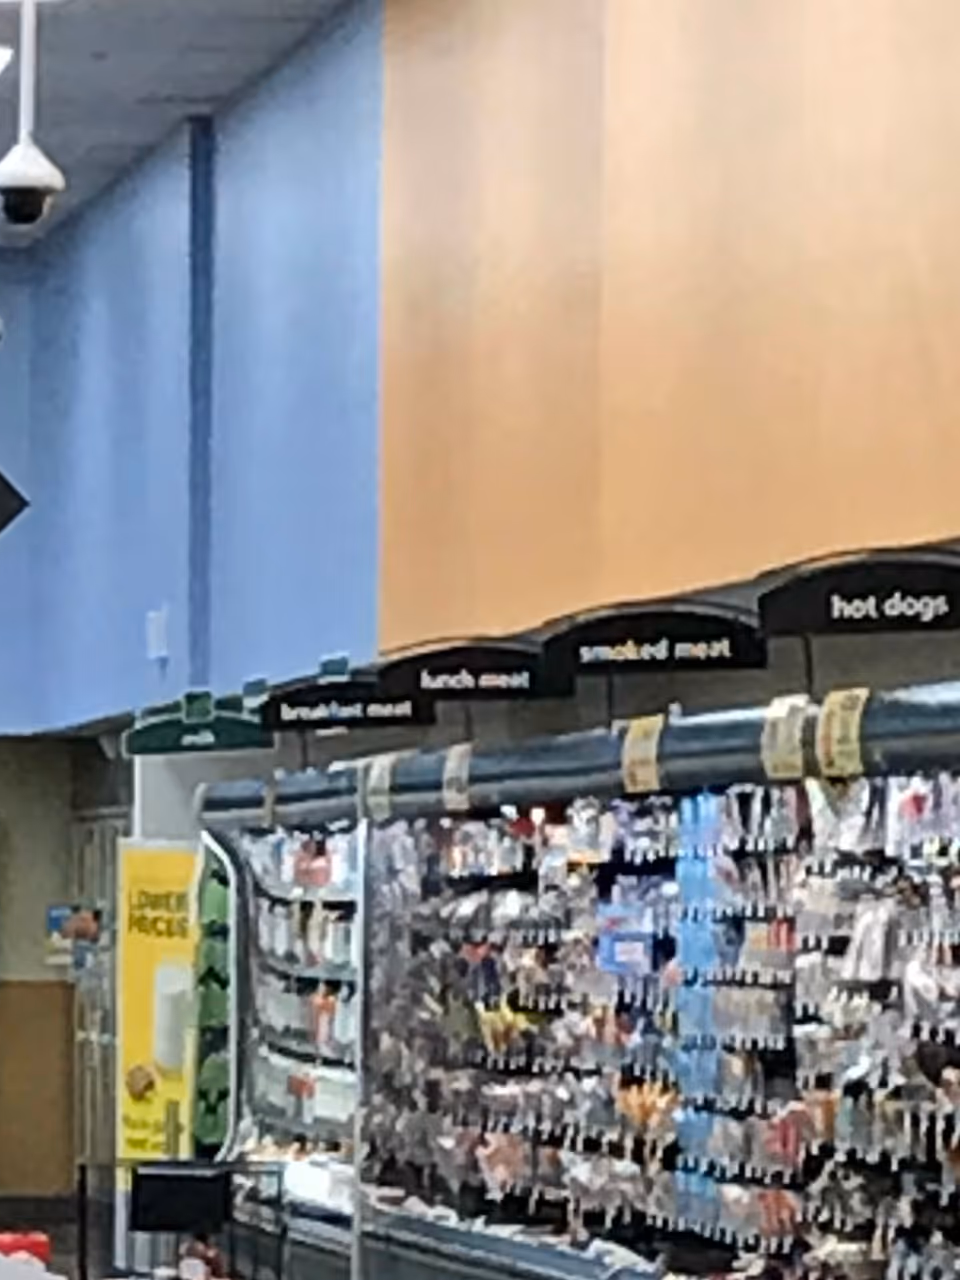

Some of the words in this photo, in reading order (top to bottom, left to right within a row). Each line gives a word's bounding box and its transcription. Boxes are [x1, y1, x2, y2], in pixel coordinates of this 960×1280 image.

[831, 594, 878, 620] hot
[883, 591, 949, 622] dogs
[579, 638, 669, 662] smoked
[674, 638, 732, 659] meat
[420, 669, 475, 689] lunch
[280, 701, 364, 720] breakfast
